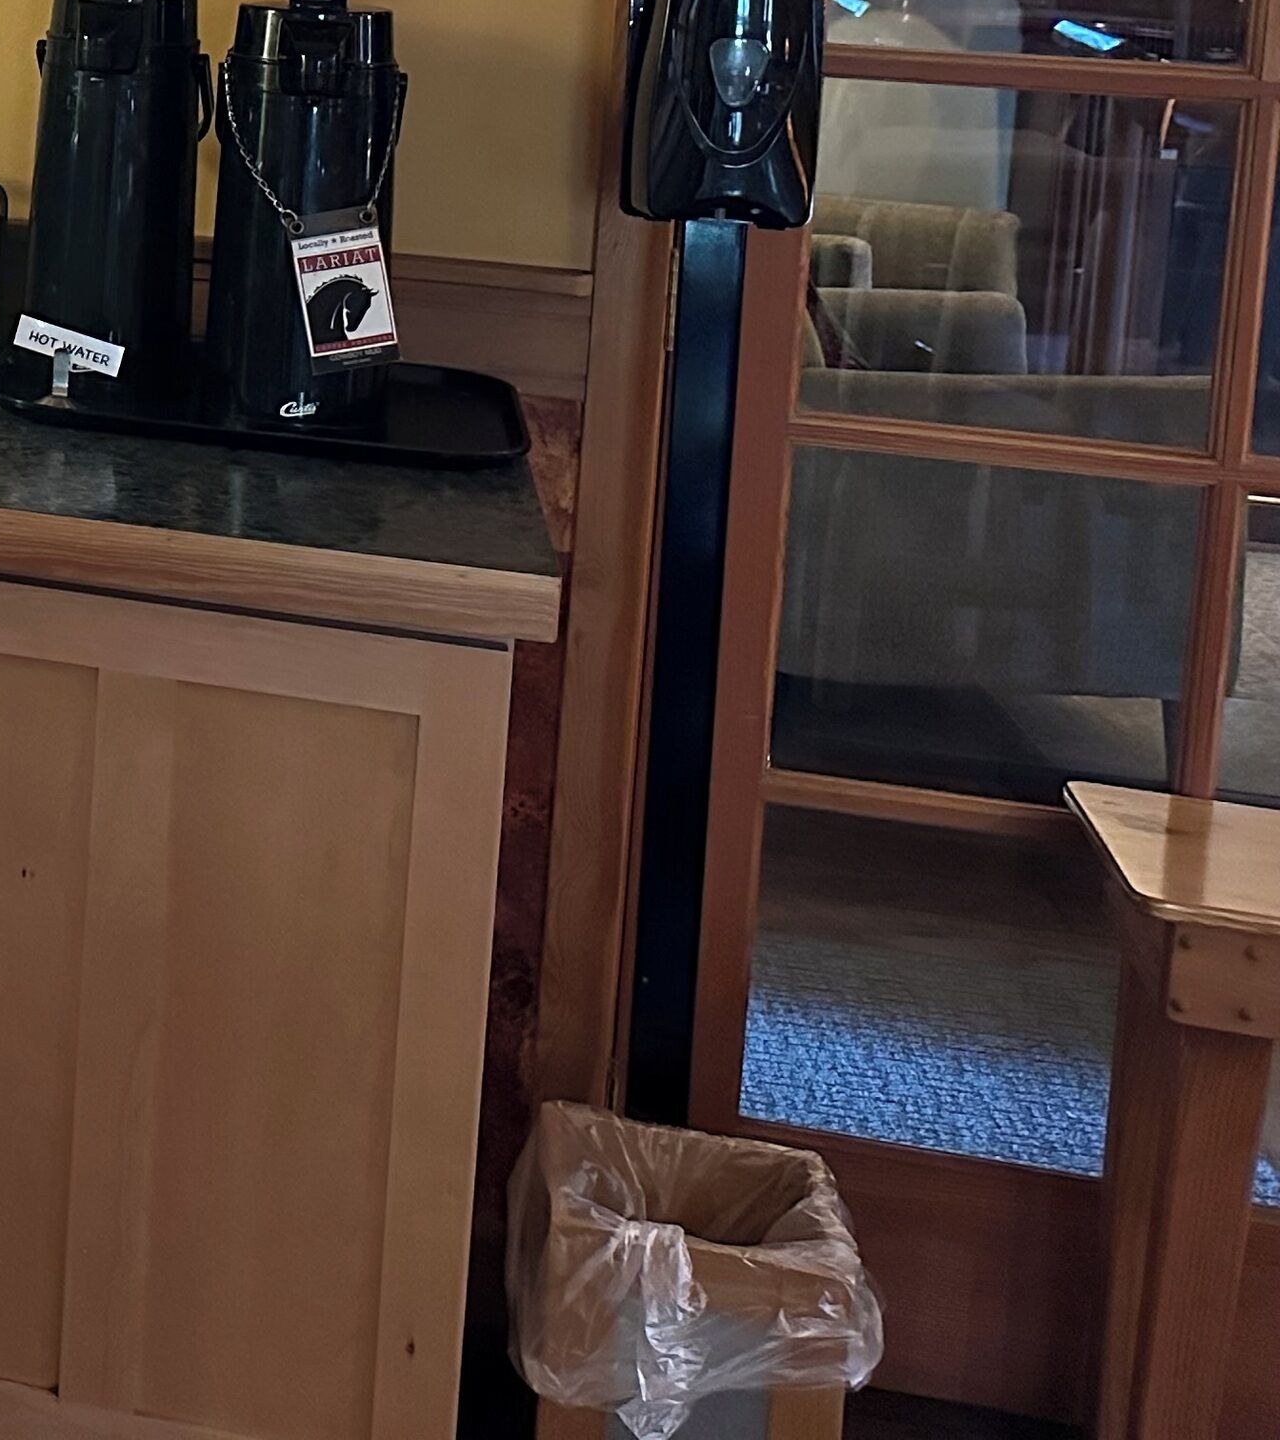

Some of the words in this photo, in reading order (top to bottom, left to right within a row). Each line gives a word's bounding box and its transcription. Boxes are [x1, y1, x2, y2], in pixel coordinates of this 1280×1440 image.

[298, 239, 329, 251] Locally
[339, 230, 374, 244] Roasted
[301, 247, 378, 272] LARIAT
[28, 330, 59, 349] HOT
[62, 340, 111, 367] WATER
